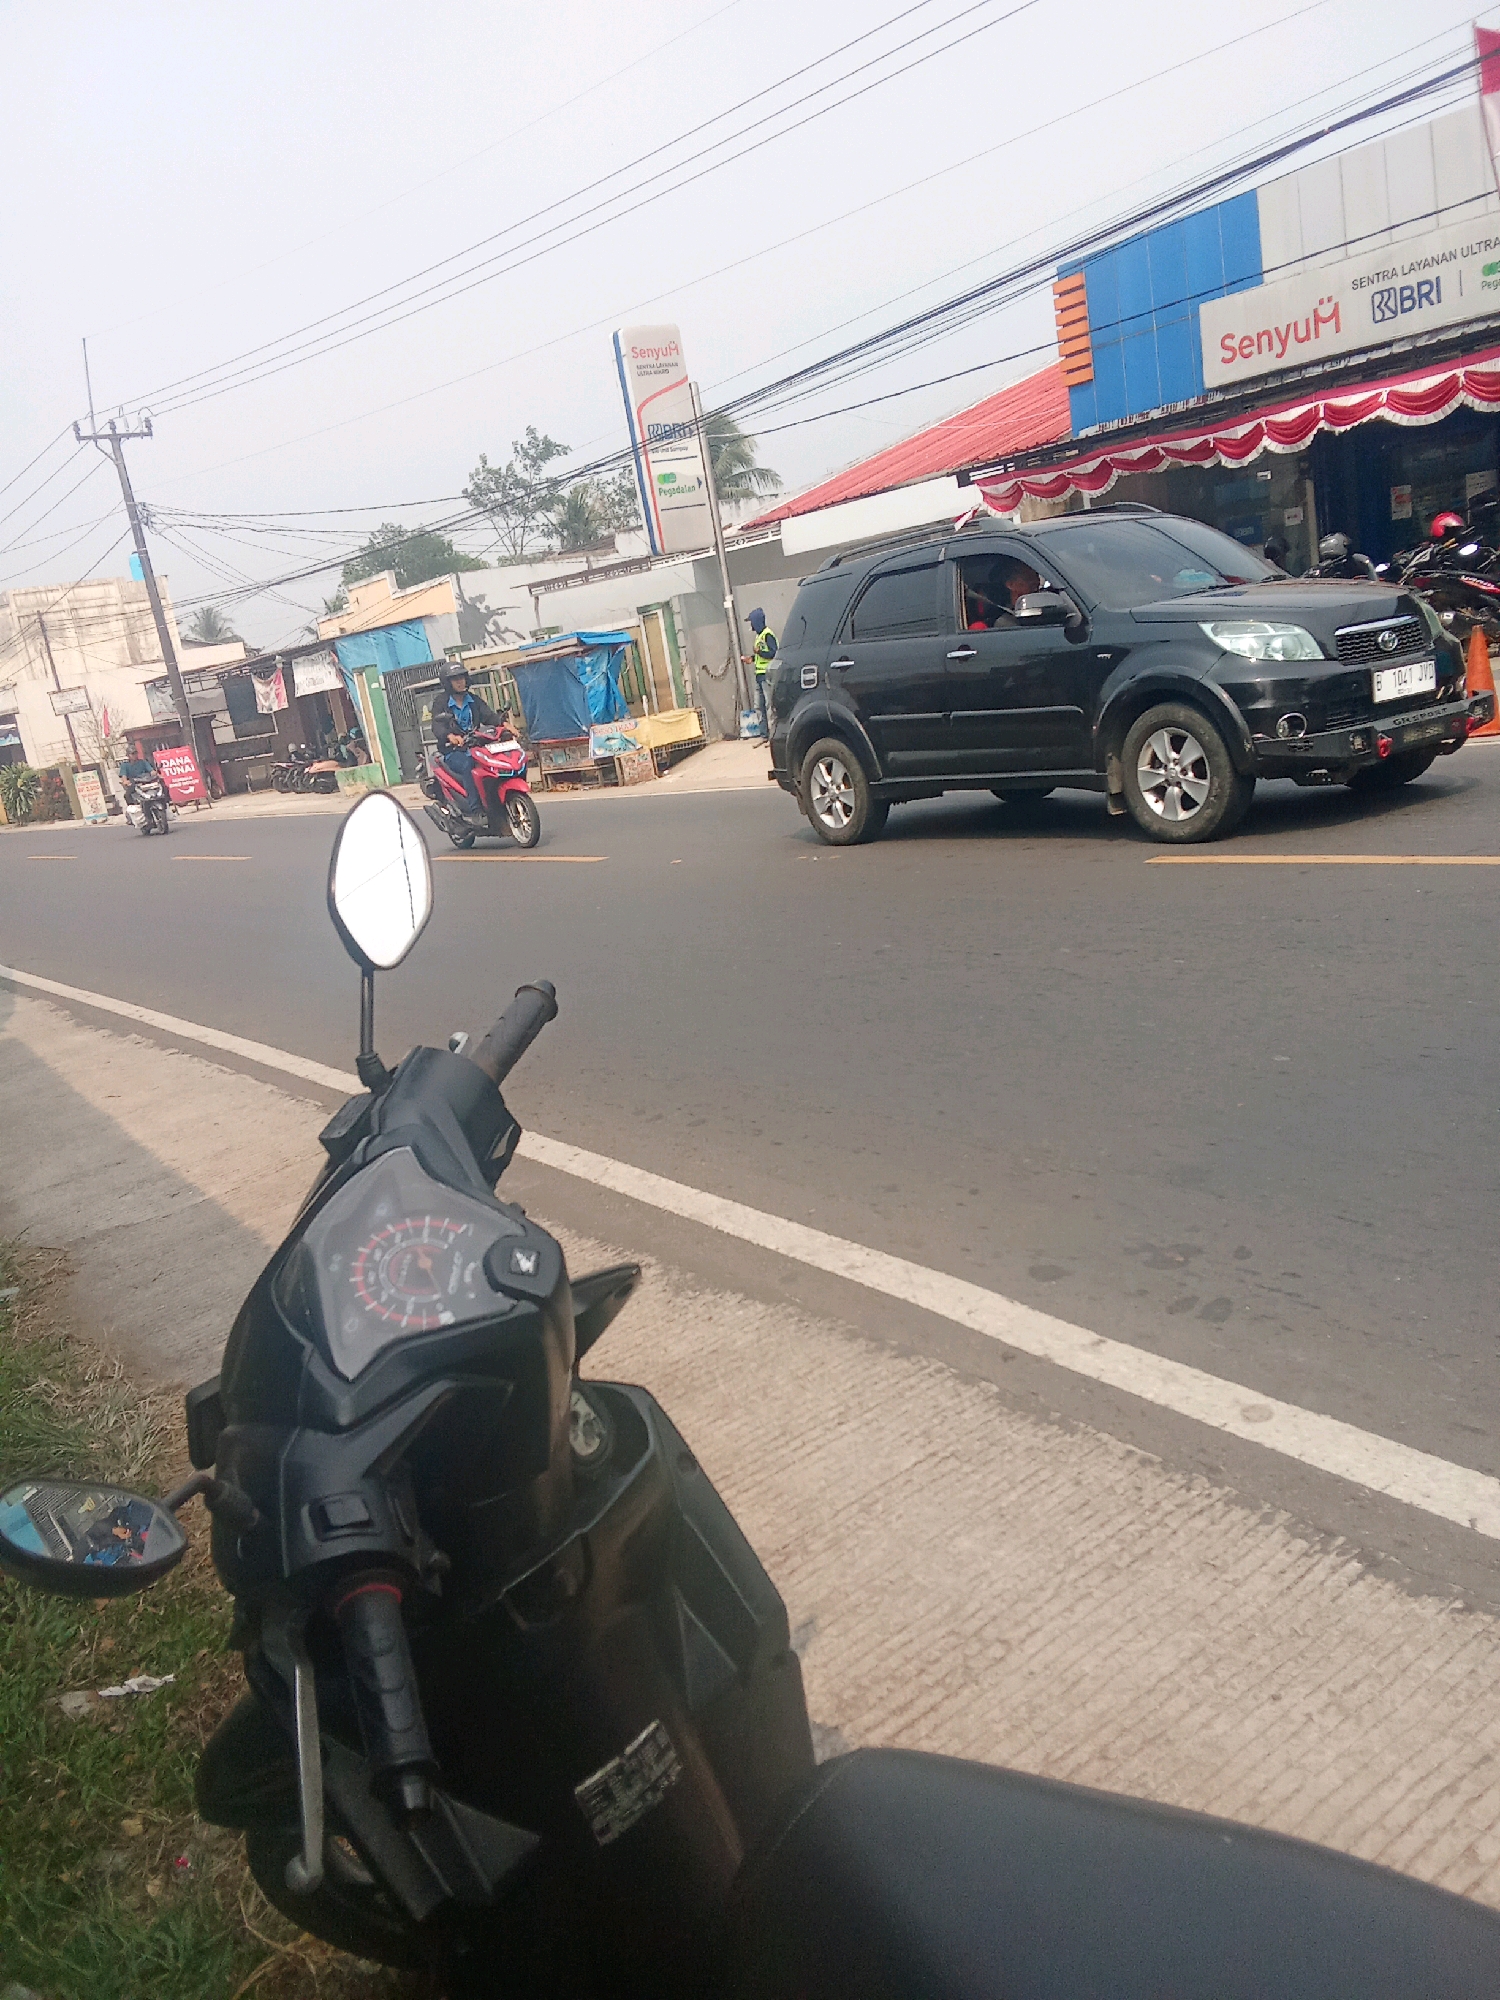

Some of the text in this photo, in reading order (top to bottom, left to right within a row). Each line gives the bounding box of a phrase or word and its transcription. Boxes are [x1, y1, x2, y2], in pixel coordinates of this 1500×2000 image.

[1351, 268, 1399, 291] SENTRA
[1401, 249, 1458, 276] LAYANAN
[1399, 275, 1442, 315] BRI
[1376, 673, 1383, 692] B
[160, 756, 192, 768] DANA
[163, 764, 195, 776] TUNAI
